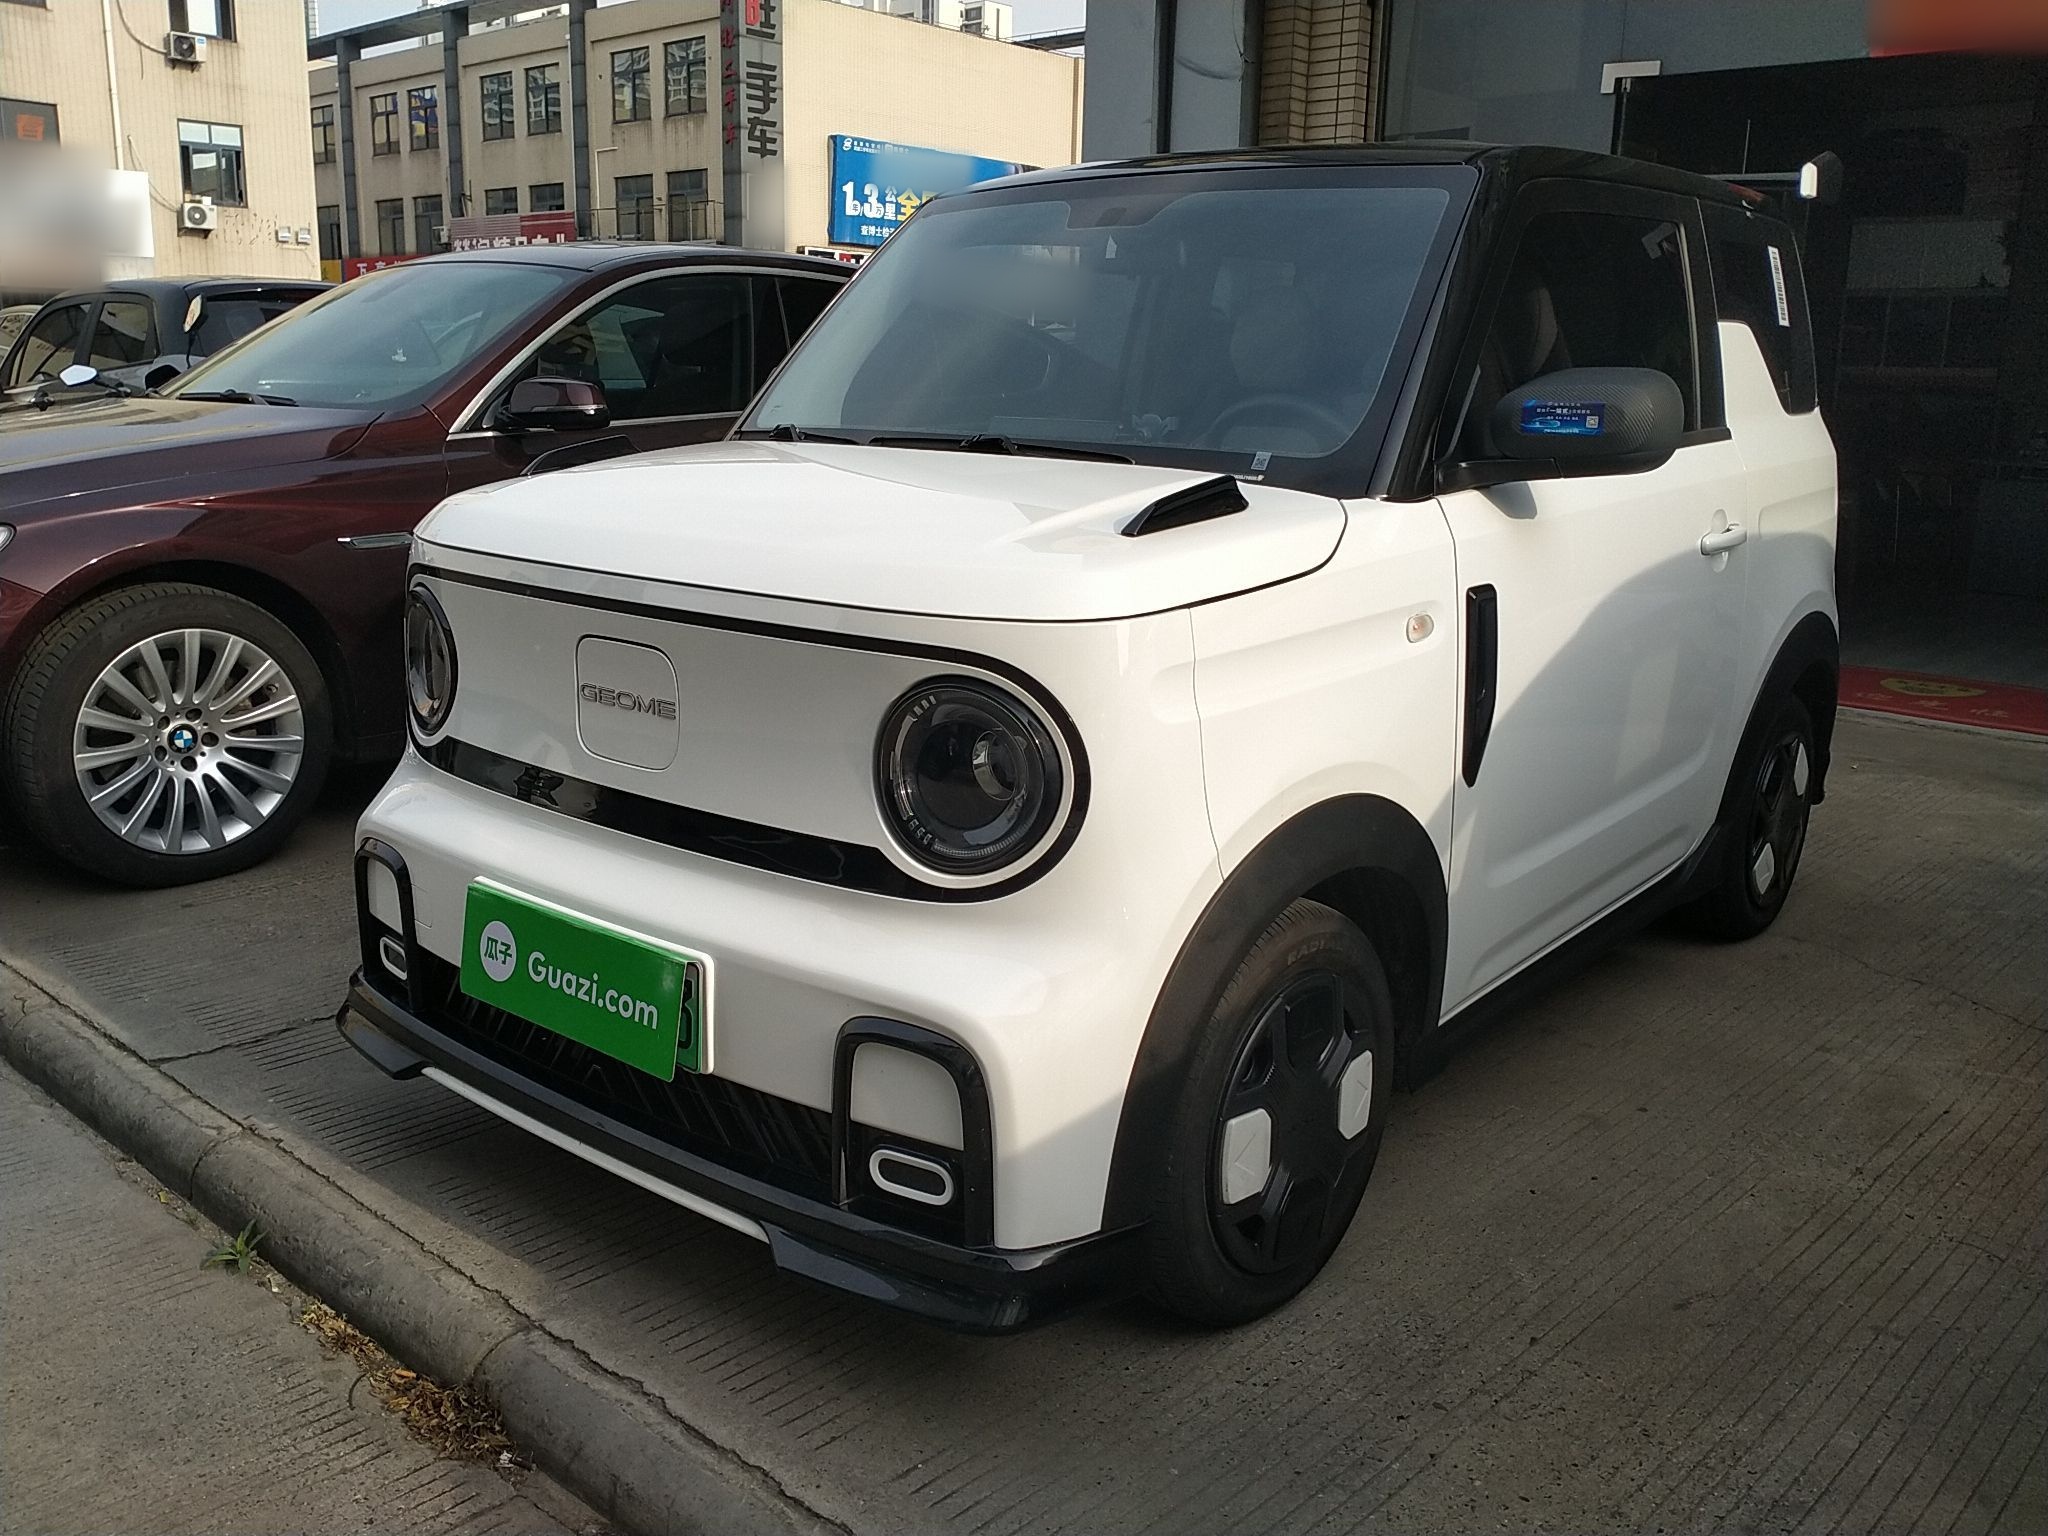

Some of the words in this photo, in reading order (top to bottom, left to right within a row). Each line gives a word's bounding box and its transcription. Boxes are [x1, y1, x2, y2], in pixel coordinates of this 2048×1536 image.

[580, 683, 676, 721] GEOME
[484, 936, 513, 965] 瓜子
[528, 951, 658, 1030] Guazi.com
